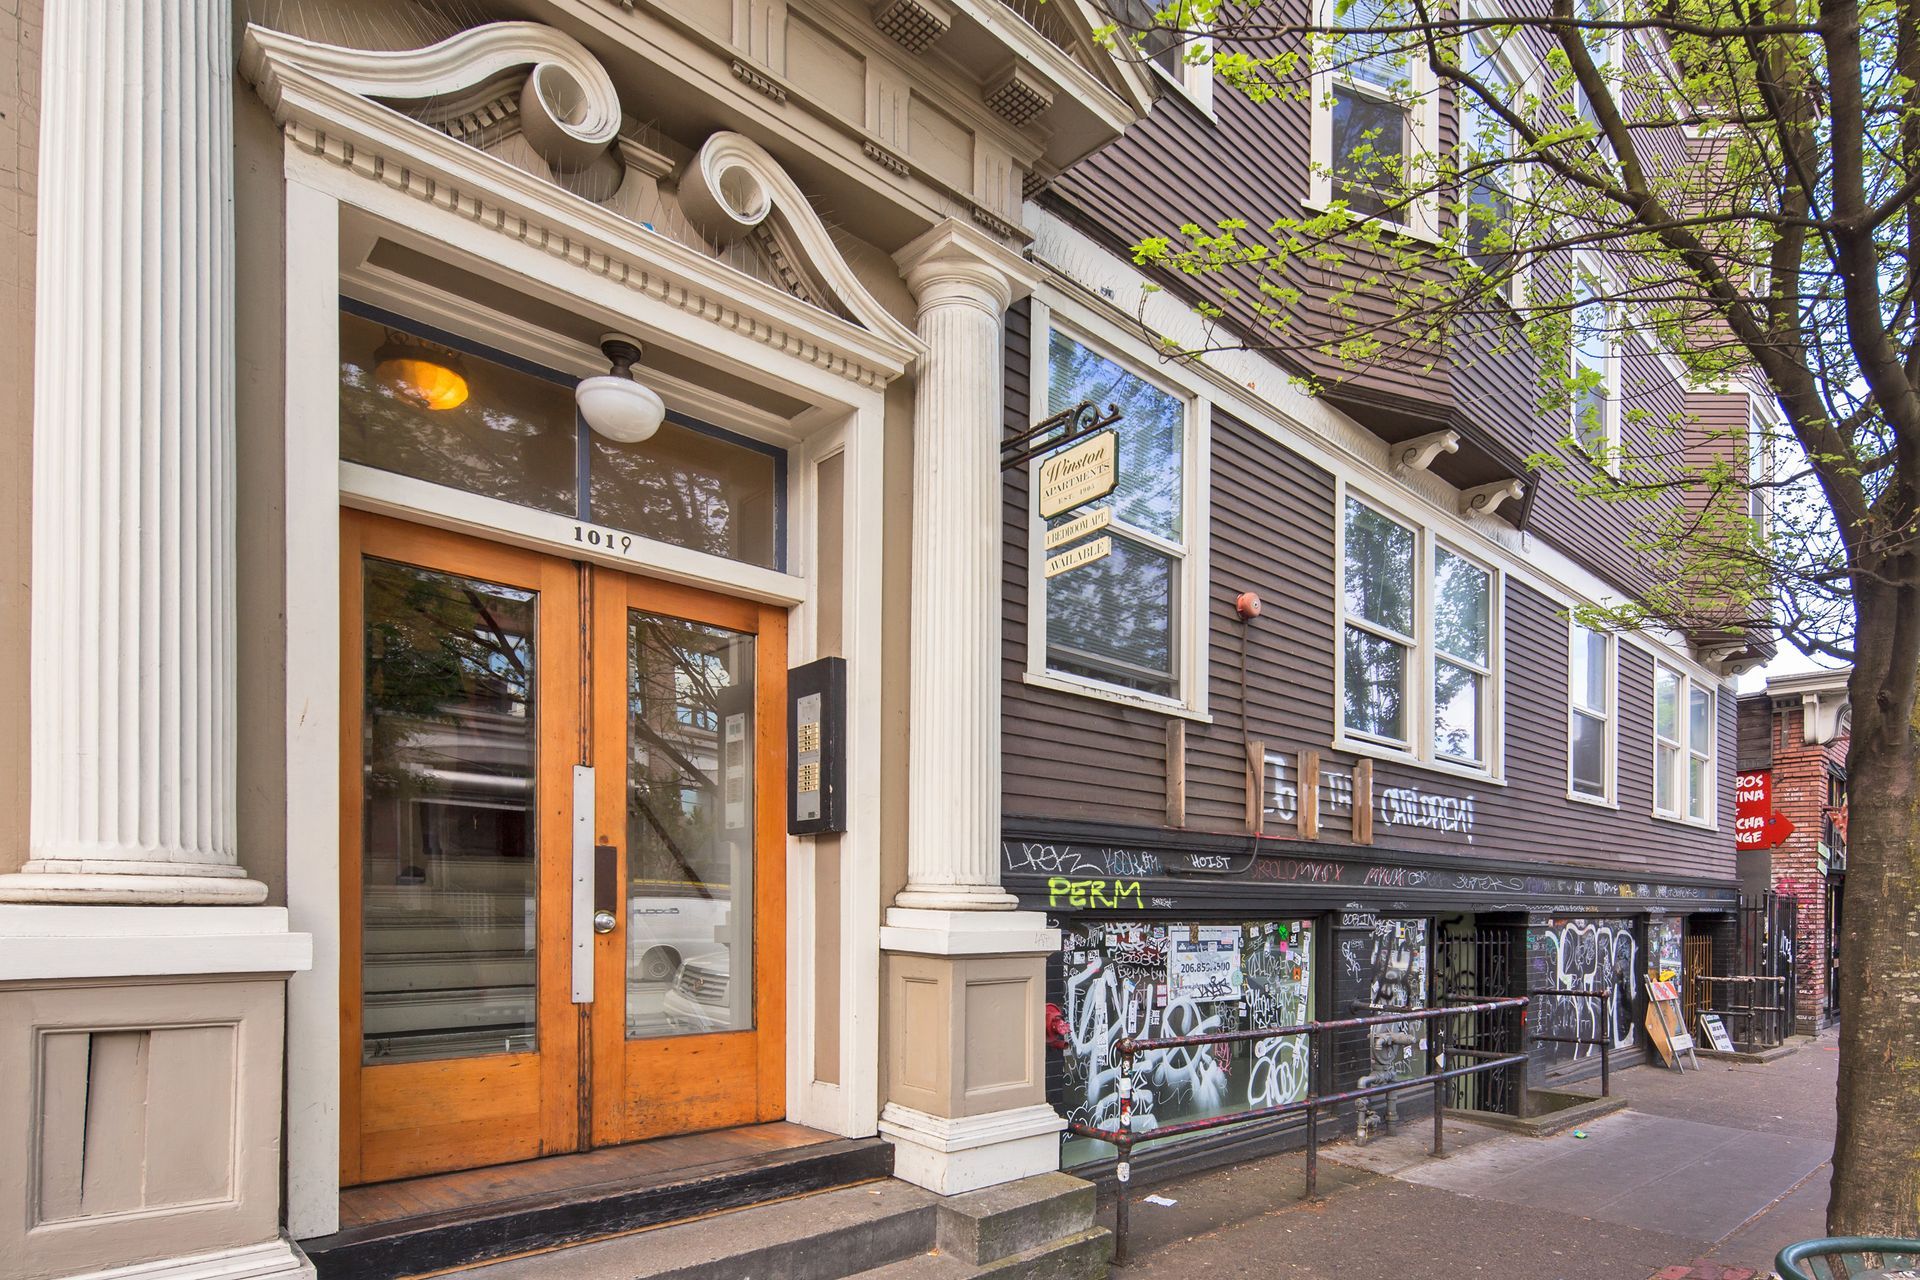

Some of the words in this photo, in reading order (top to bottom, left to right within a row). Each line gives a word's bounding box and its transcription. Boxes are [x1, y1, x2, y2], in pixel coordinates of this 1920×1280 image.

[1043, 463, 1110, 499] APARTMENTS
[1047, 447, 1105, 484] Winston
[574, 526, 632, 555] 1019
[1051, 519, 1090, 543] BEDROOM
[1049, 541, 1105, 573] AVAILABLE
[1191, 853, 1232, 870] HOIST
[1048, 877, 1144, 909] PERM
